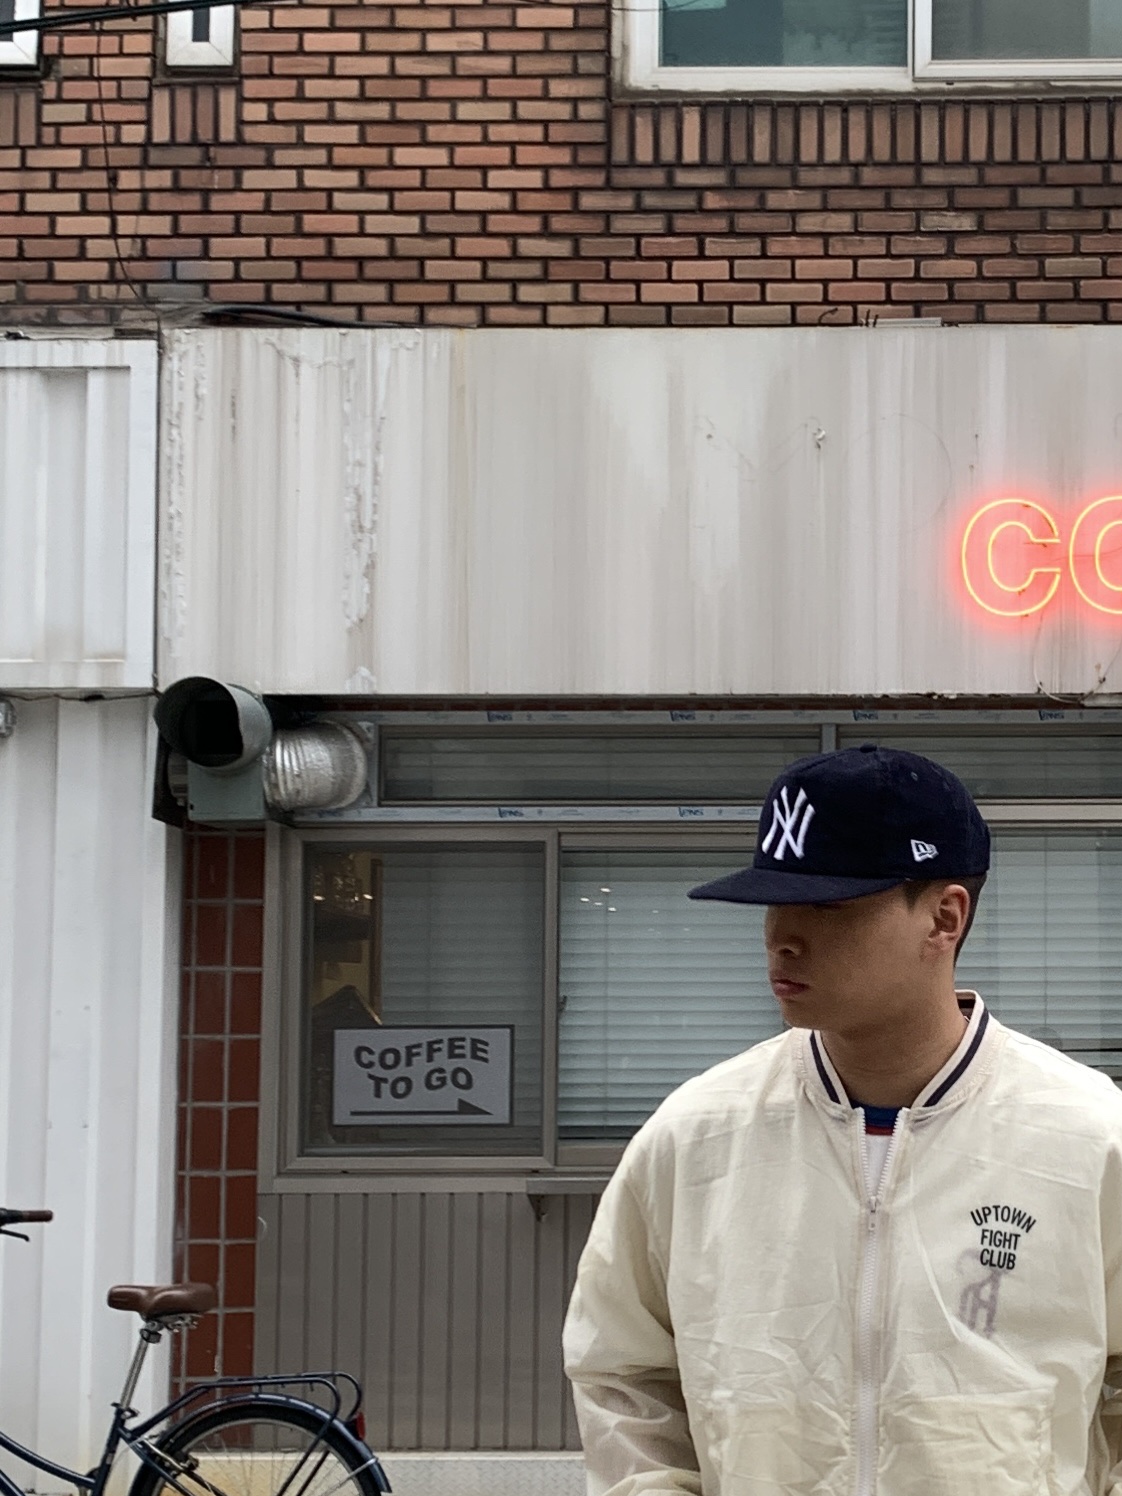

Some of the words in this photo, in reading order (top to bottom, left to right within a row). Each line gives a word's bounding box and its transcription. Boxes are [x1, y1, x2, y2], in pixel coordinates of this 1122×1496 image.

[761, 785, 816, 861] NY
[354, 1036, 489, 1070] COFFEE
[367, 1072, 413, 1099] TO
[424, 1067, 474, 1091] GO
[970, 1205, 1037, 1233] UPTOWN
[980, 1229, 1021, 1250] FIGHT
[980, 1249, 1016, 1270] CLUB
